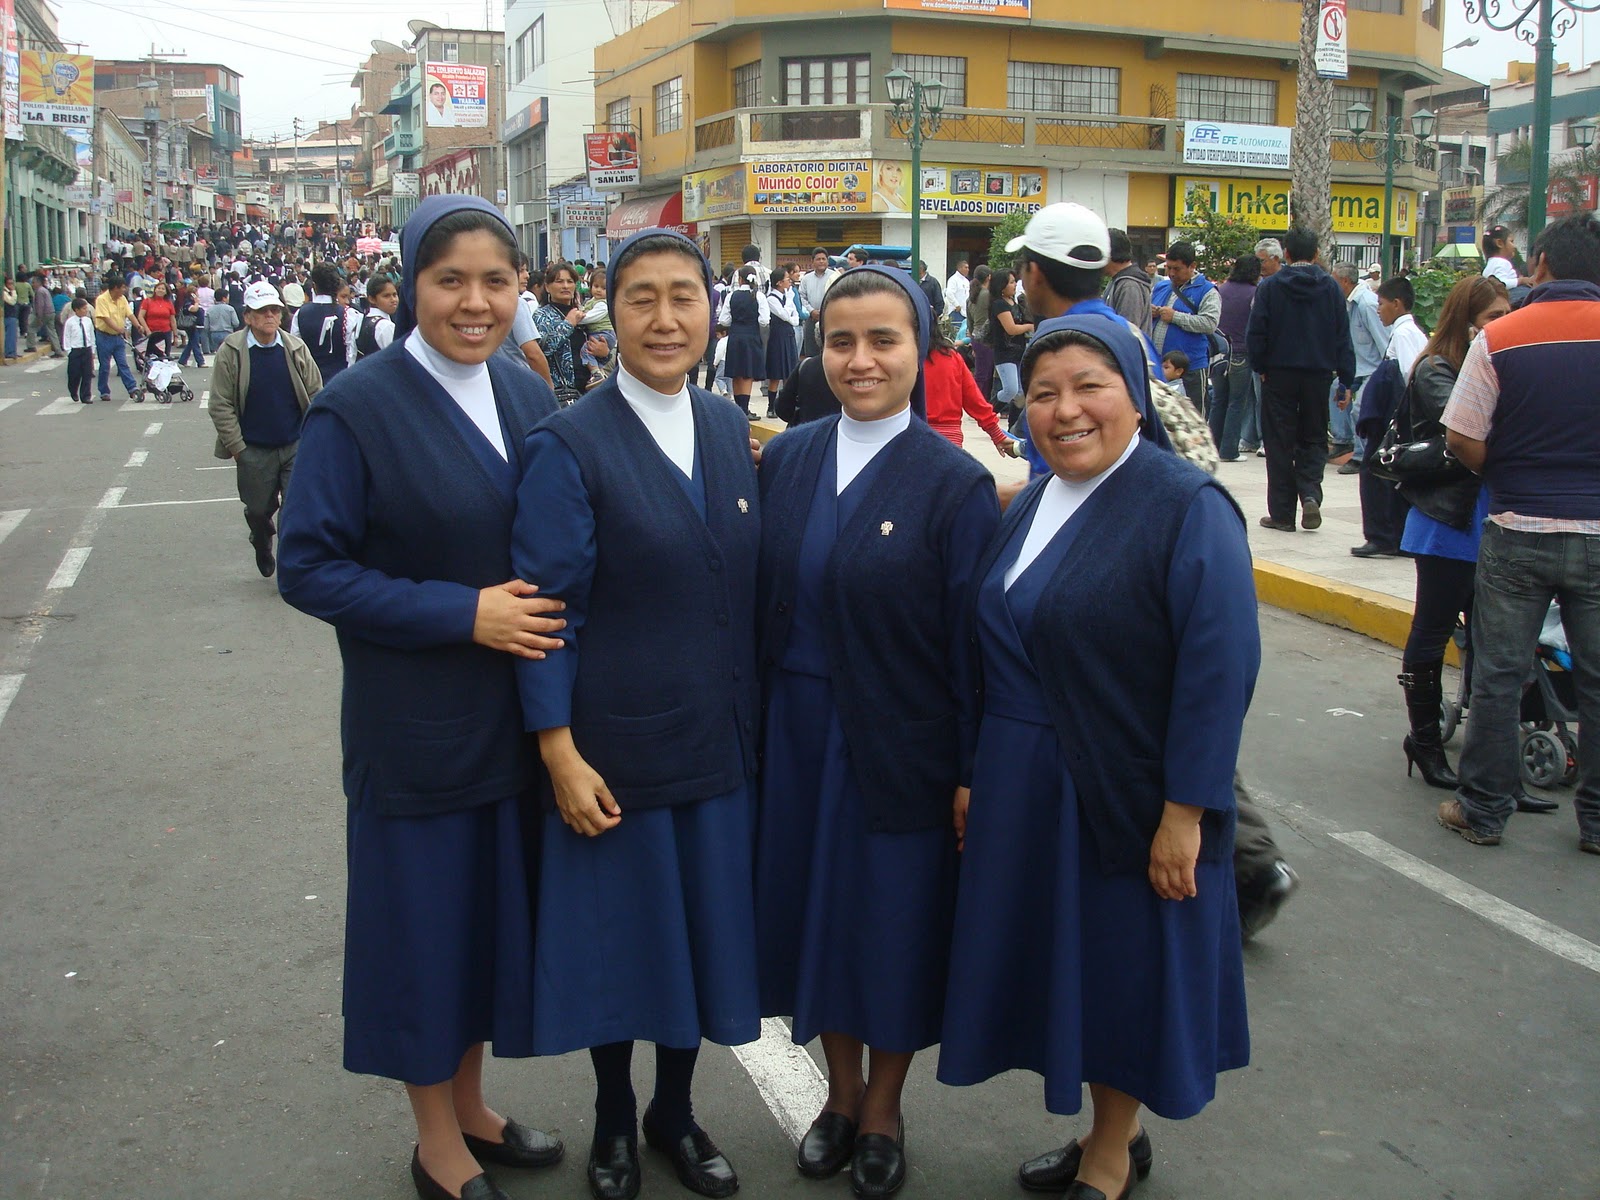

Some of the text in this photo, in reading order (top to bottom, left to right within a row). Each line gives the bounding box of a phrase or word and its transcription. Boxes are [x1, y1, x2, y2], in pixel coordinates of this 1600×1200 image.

[1195, 128, 1221, 140] EFE
[1222, 135, 1238, 145] EFE
[1238, 138, 1282, 148] AUTOMOTRIZ
[1186, 148, 1288, 165] ENTIDAD VERIFICADORA DE VEHICULOS USADOS
[752, 162, 868, 174] LABORATORIO DIGITAL
[758, 175, 839, 190] Mundo Color
[792, 205, 837, 213] AREQUIPA
[920, 198, 982, 213] REVELADOS
